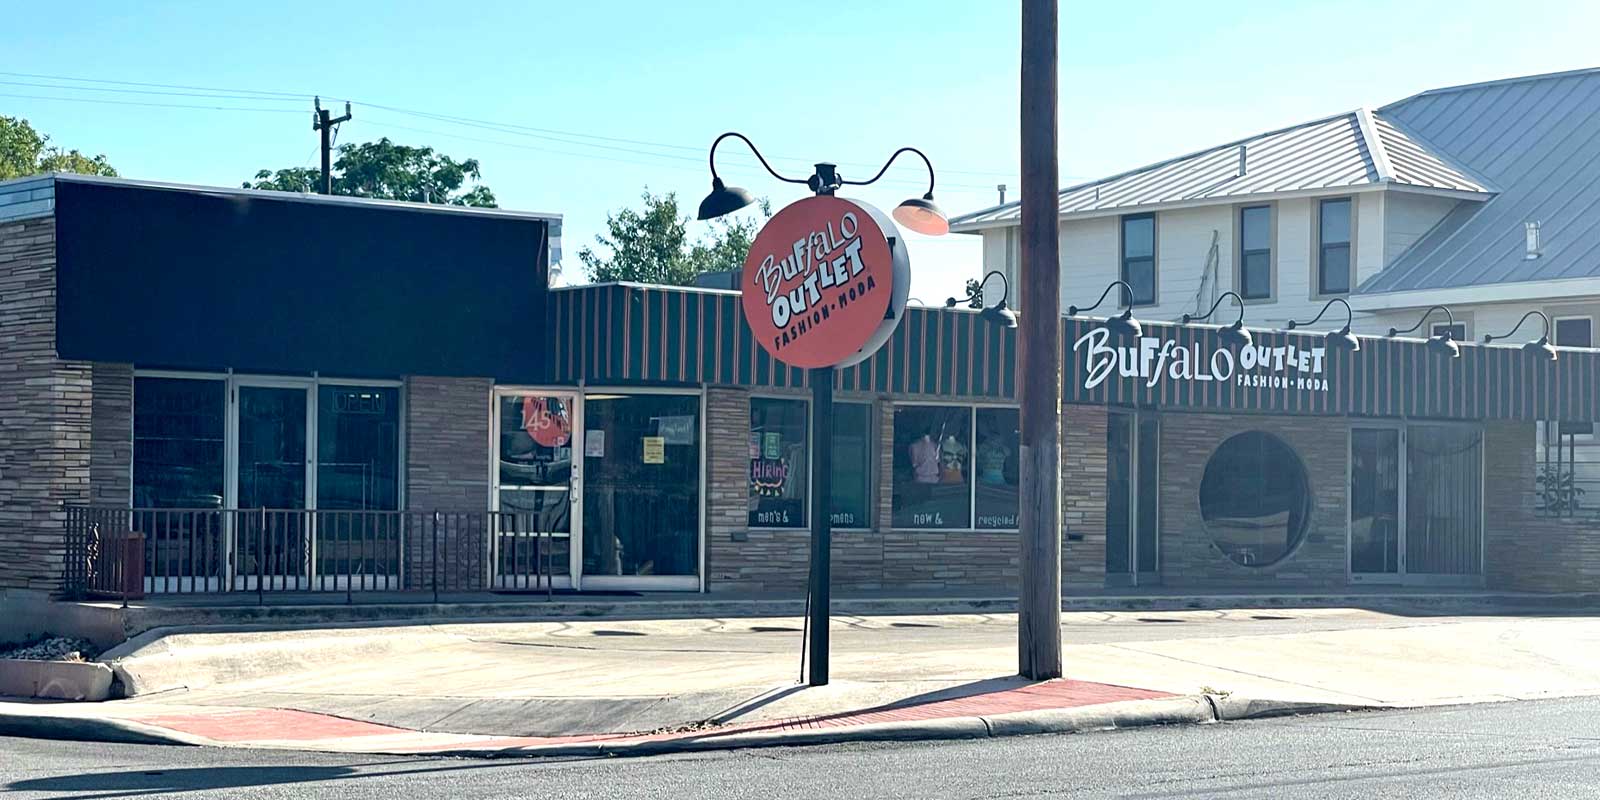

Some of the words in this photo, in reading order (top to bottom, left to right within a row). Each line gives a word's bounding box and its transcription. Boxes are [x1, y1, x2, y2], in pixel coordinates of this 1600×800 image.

[771, 236, 865, 329] OUTLET
[1239, 344, 1326, 374] OUTLET
[519, 409, 551, 431] 145
[782, 509, 790, 523] &
[830, 512, 854, 524] mens
[935, 511, 943, 525] &
